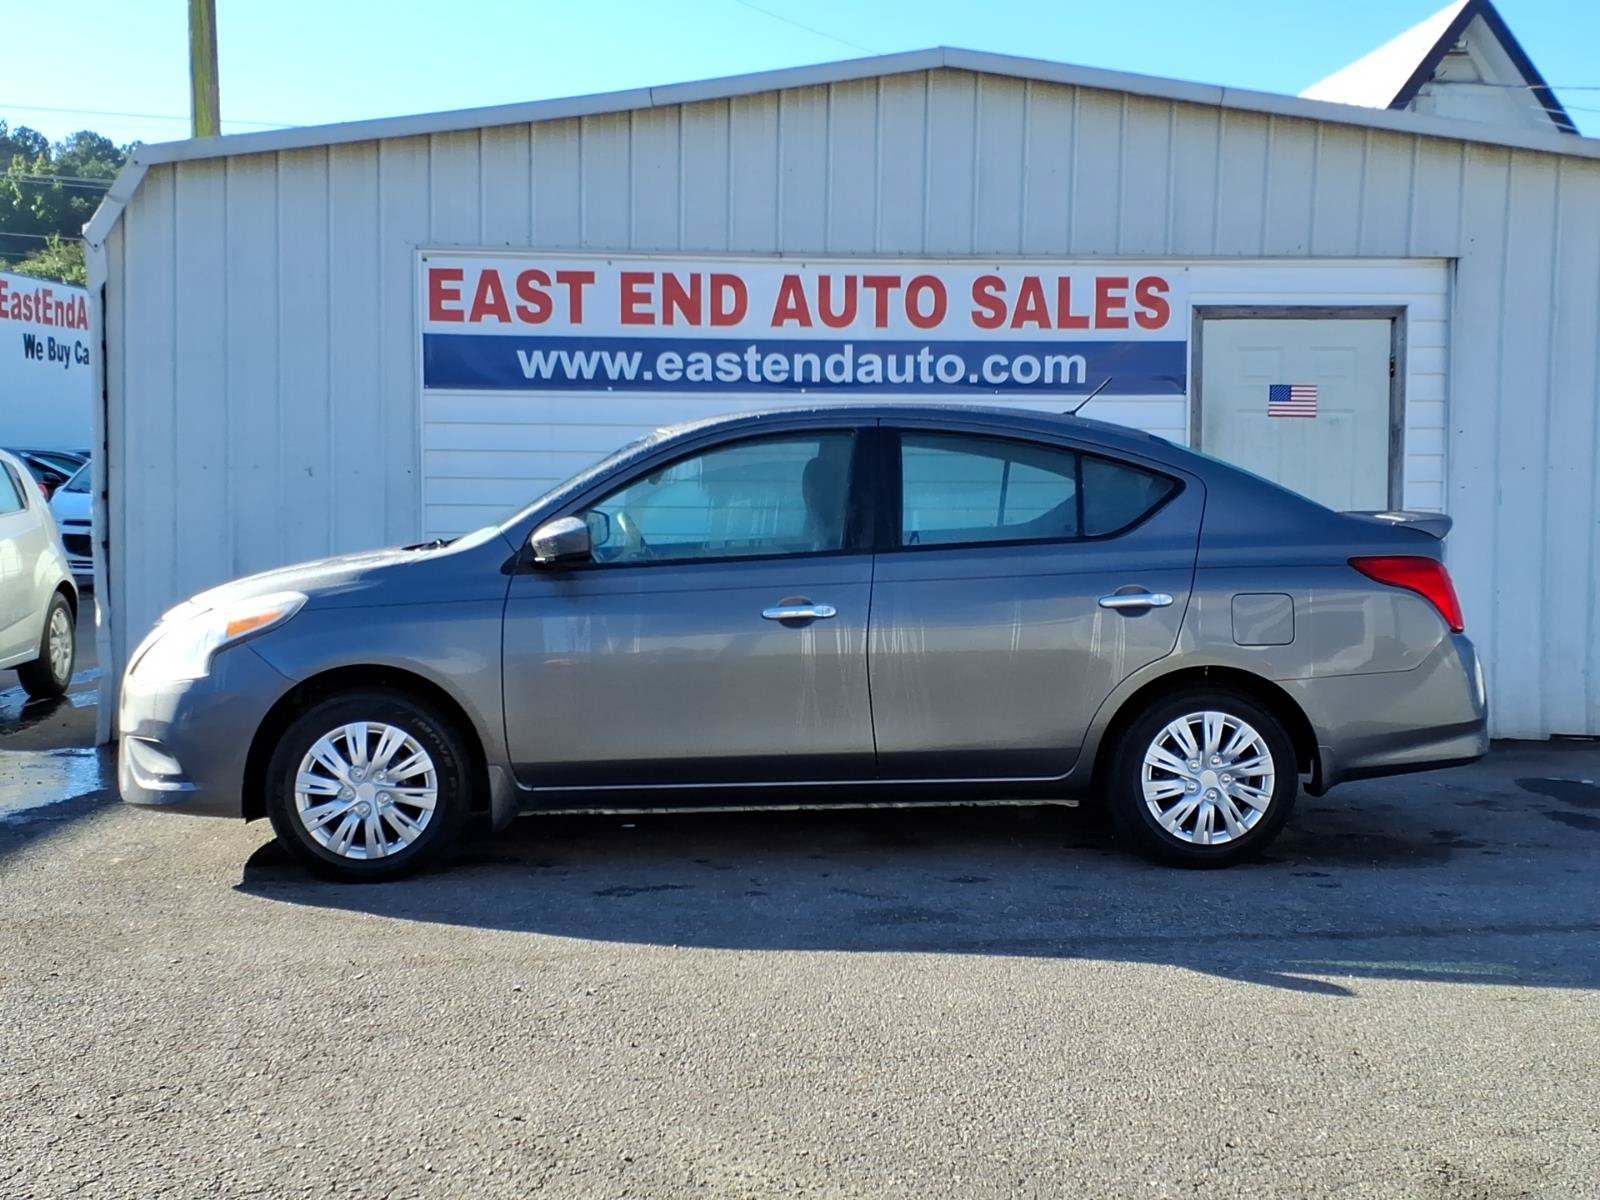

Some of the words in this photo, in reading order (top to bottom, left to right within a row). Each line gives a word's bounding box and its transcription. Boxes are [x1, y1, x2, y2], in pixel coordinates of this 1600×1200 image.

[428, 268, 596, 325] EAST
[619, 271, 749, 328] END
[770, 274, 948, 330] AUTO
[971, 275, 1171, 331] SALES
[23, 333, 43, 360] We
[48, 337, 71, 370] Buy
[516, 343, 1087, 386] www.eastendauto.com
